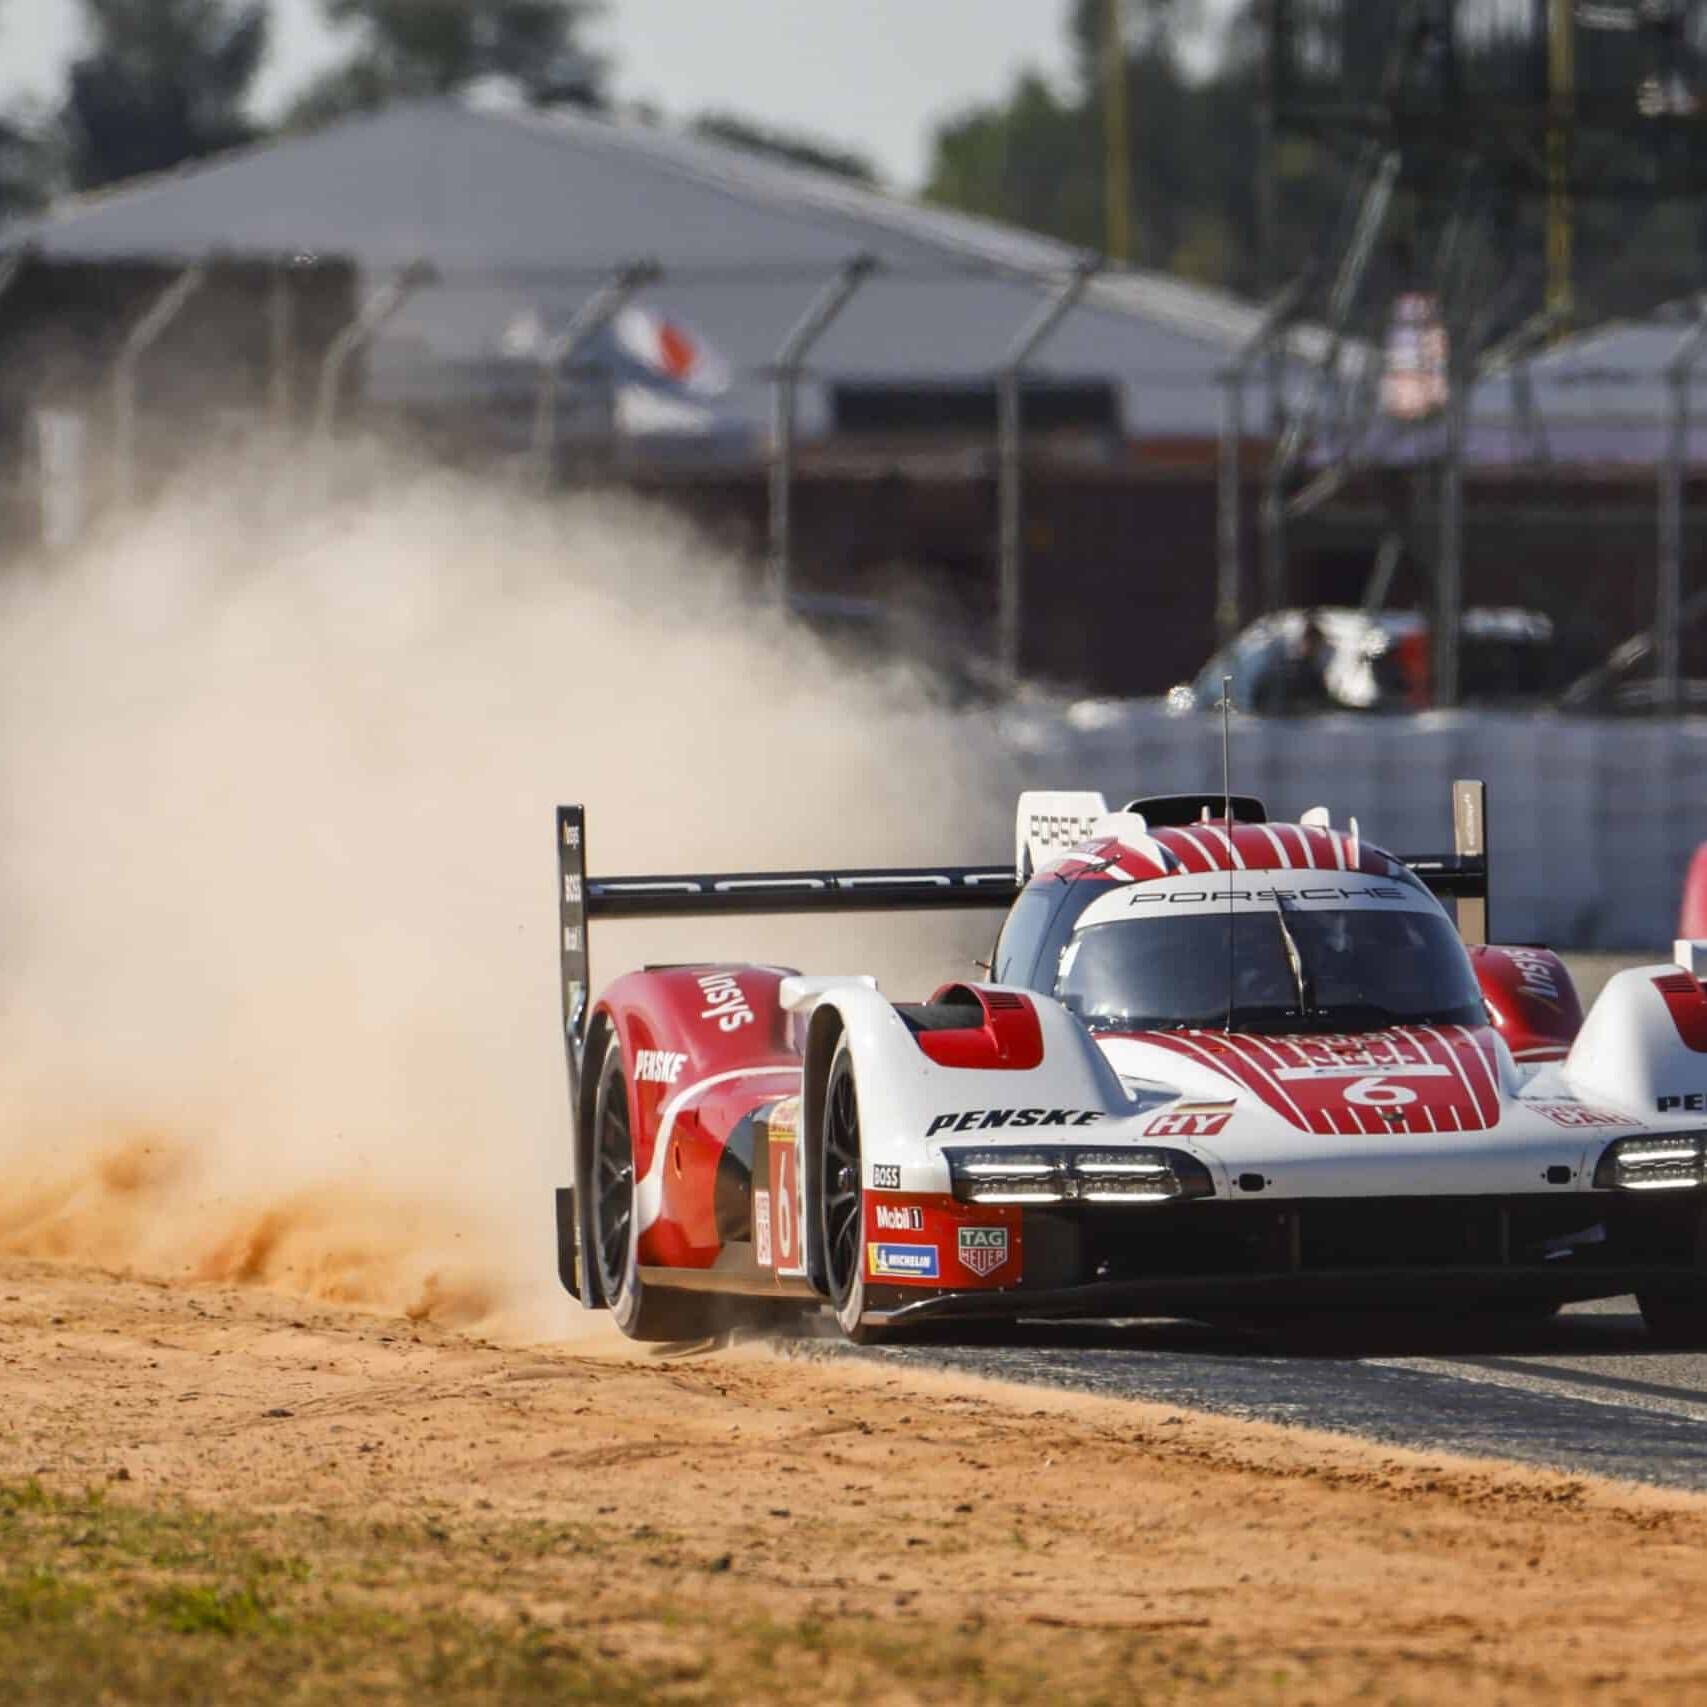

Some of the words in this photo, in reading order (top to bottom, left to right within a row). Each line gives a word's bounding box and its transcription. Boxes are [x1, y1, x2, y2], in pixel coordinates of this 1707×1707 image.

[1129, 887, 1406, 906] PORSCHE
[634, 1049, 688, 1084] PENSKE
[1343, 1077, 1418, 1106] 6
[926, 1108, 1105, 1137] PENSKE
[1149, 1113, 1231, 1135] HY
[874, 1166, 898, 1187] BOSS
[778, 1152, 791, 1258] 6
[876, 1205, 910, 1229] Mobil
[912, 1208, 920, 1229] 1
[962, 1231, 1002, 1246] TAG
[888, 1254, 931, 1269] MICHELIN
[962, 1249, 1004, 1272] HEUER
